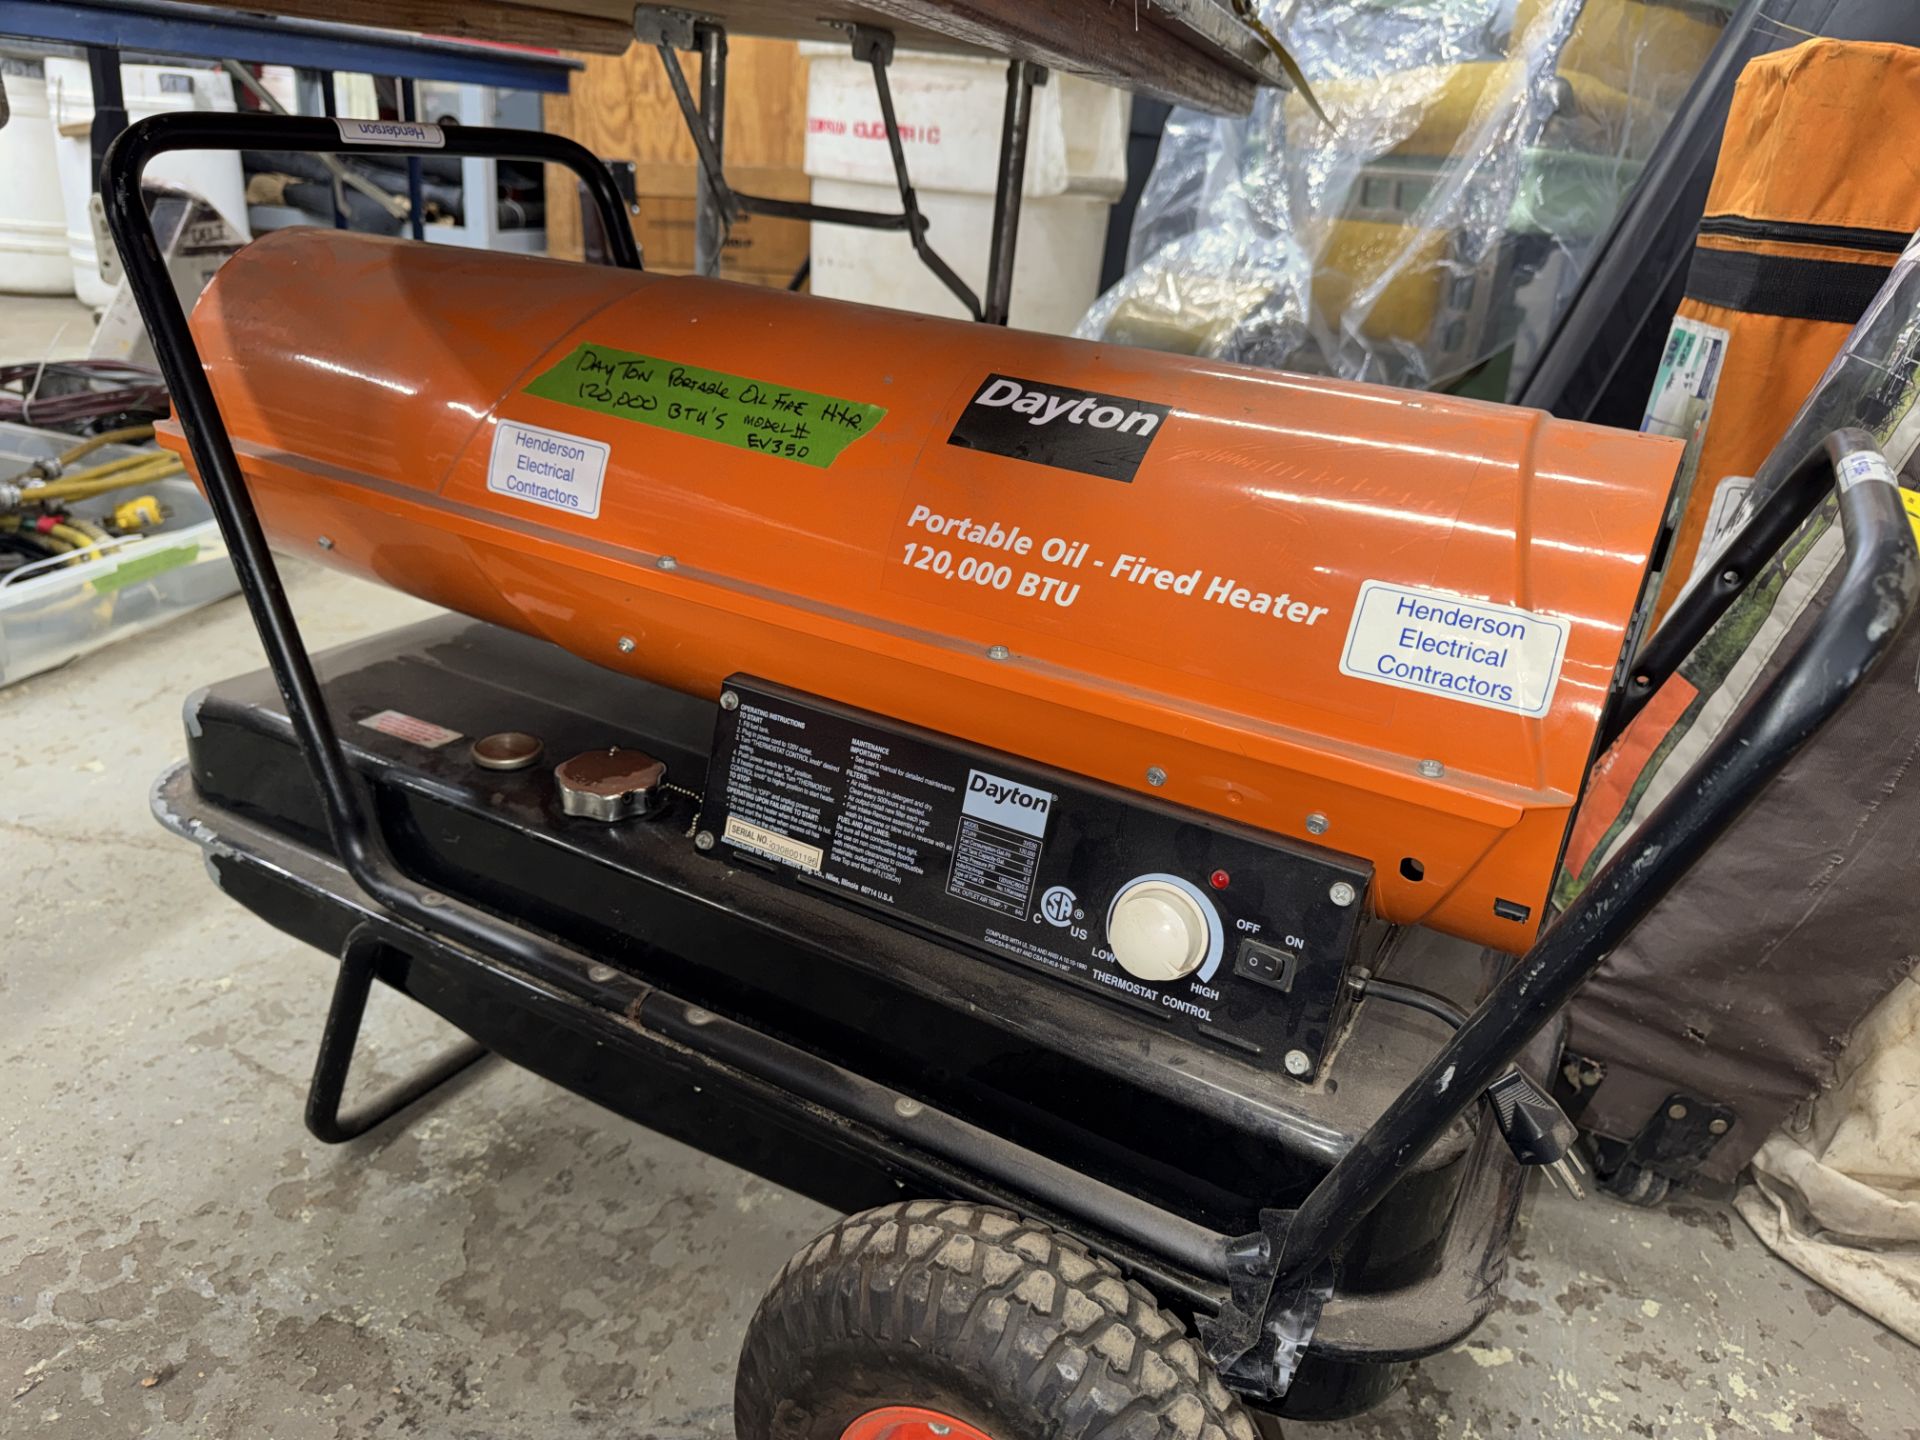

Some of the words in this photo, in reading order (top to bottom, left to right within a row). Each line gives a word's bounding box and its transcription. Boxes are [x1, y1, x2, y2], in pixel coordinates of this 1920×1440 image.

[358, 123, 426, 140] Henderson
[578, 382, 657, 410] 120,000
[974, 379, 1160, 438] Dayton
[516, 431, 585, 462] Henderson
[517, 454, 575, 482] Electrical
[506, 474, 579, 507] Contractors
[902, 542, 1012, 590] 120,000
[1016, 571, 1080, 608] BTU
[907, 504, 1034, 556] Portable
[1041, 537, 1090, 569] Oil
[1110, 554, 1202, 596] Fired
[1202, 576, 1329, 626] Heater
[1396, 596, 1526, 640] Henderson
[1399, 627, 1508, 668] Electrical
[1378, 654, 1513, 702] Contractors
[740, 704, 768, 718] OPERATING
[769, 712, 806, 730] INSTRUCTIONS
[747, 714, 763, 724] START
[771, 737, 782, 747] cord
[785, 750, 809, 763] CONTROL
[851, 738, 890, 755] MAINTENANCE
[729, 770, 737, 779] TO
[880, 764, 897, 775] manual
[924, 778, 956, 793] maintenance
[727, 785, 754, 800] OPERATING
[754, 795, 769, 805] UPON
[794, 808, 801, 816] TO
[969, 774, 1048, 813] Dayton
[731, 824, 756, 840] SERIAL
[837, 815, 851, 825] FUEL
[851, 820, 864, 829] AND
[864, 824, 873, 833] AIR
[1033, 913, 1042, 924] C
[1070, 926, 1088, 940] US
[1236, 919, 1262, 934] OFF
[1285, 935, 1305, 950] ON
[1092, 946, 1116, 964] LOW
[1190, 982, 1220, 1000] HIGH
[1092, 968, 1158, 1001] THERMOSTAT
[1162, 995, 1212, 1022] CONTROL
